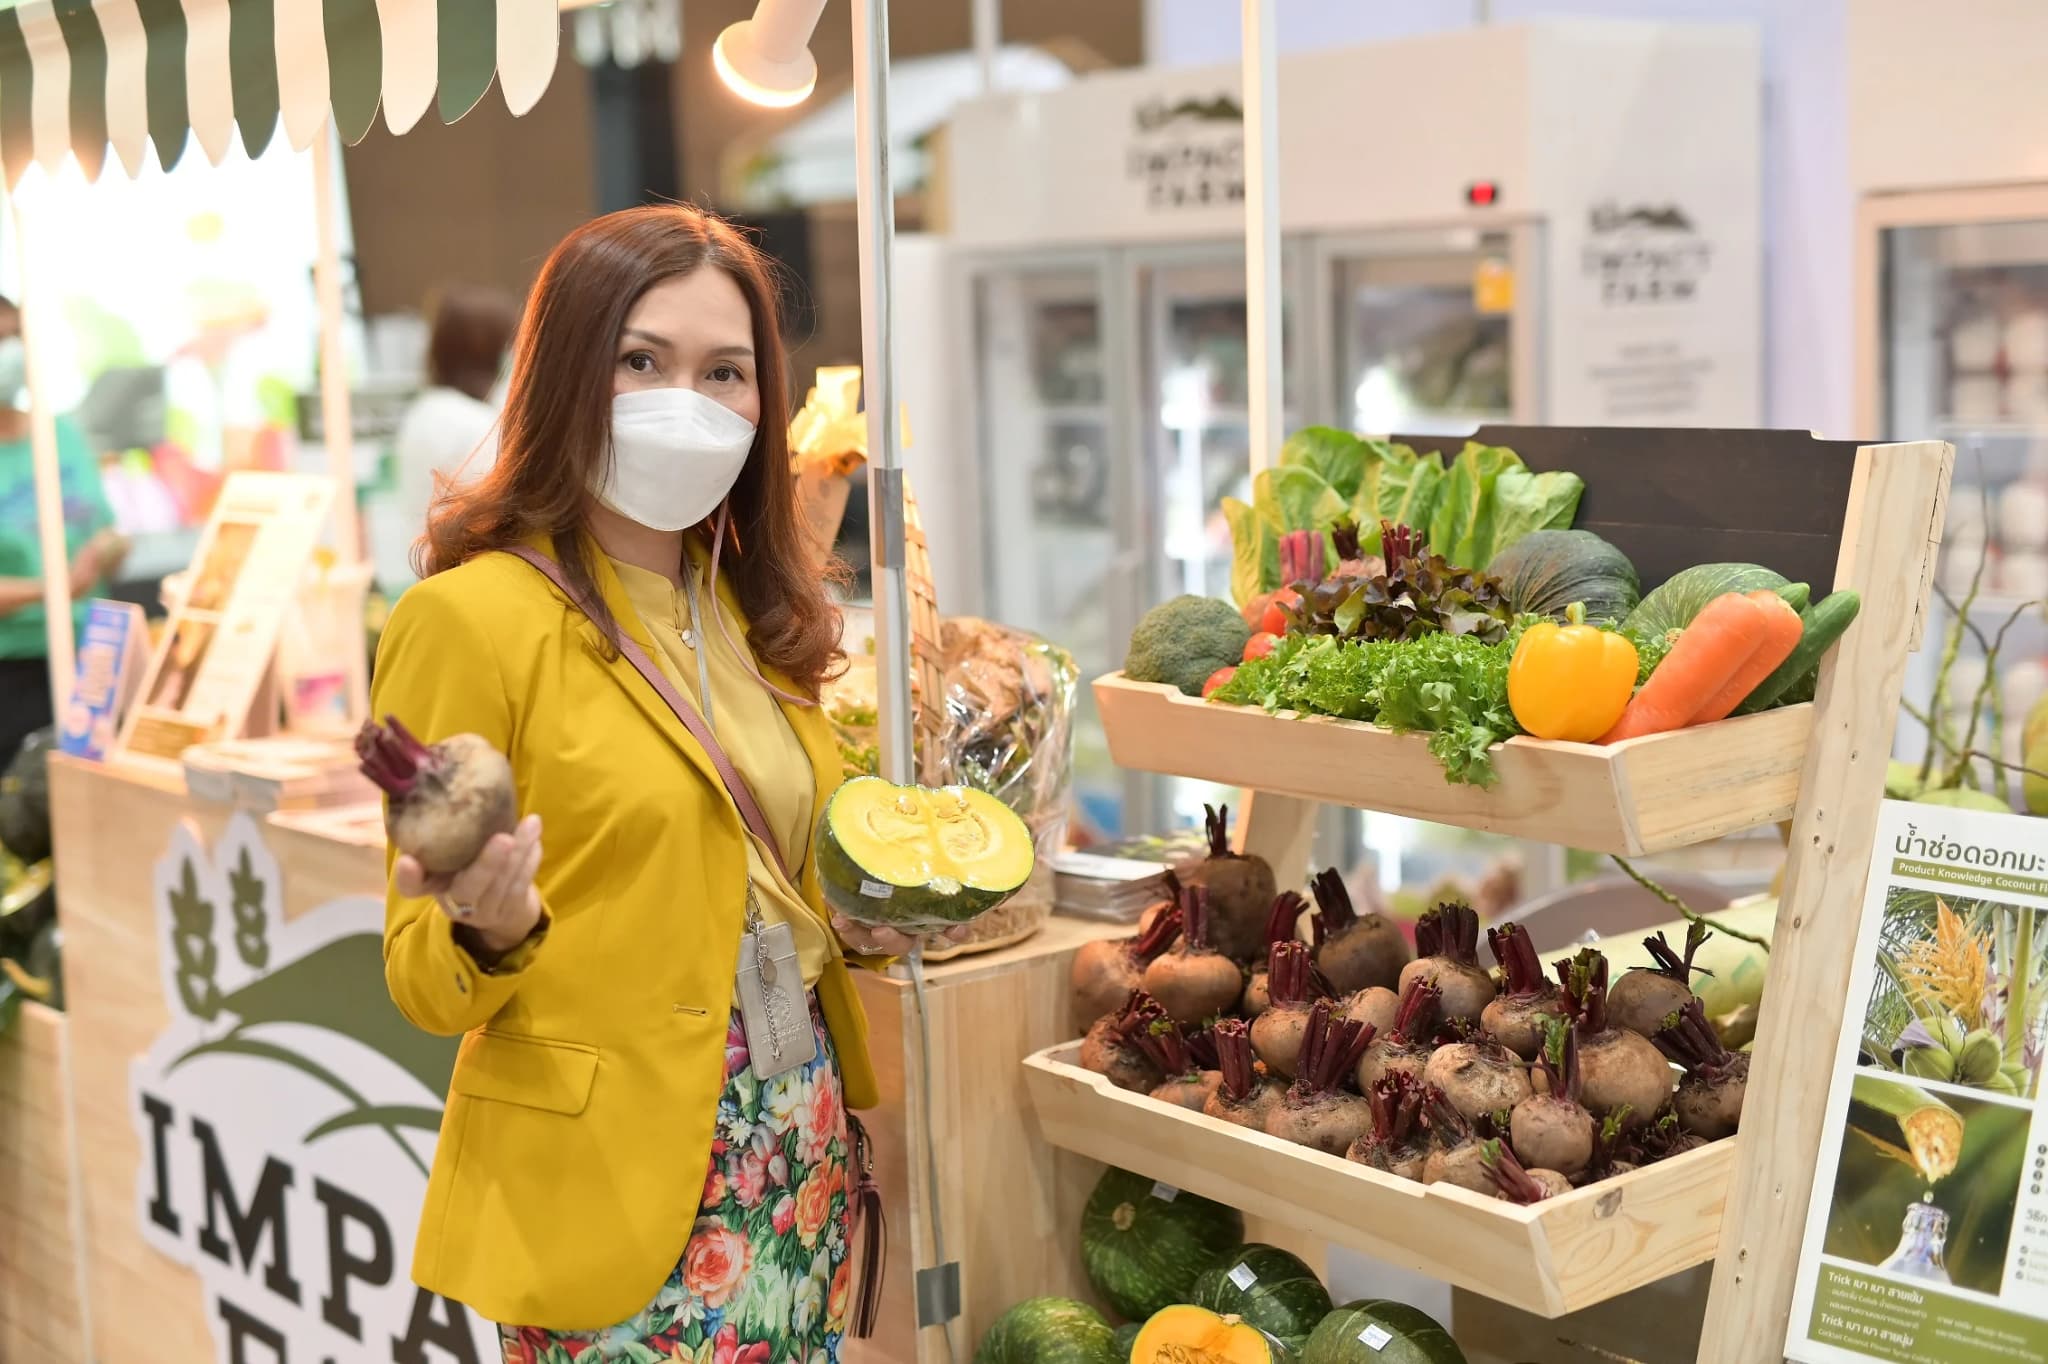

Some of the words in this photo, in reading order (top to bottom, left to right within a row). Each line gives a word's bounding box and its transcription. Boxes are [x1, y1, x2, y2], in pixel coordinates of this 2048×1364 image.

[1581, 238, 1713, 278] IMPACT
[1600, 277, 1698, 308] FARM
[1899, 862, 1935, 877] Product
[1938, 867, 1993, 885] Knowledge
[1995, 876, 2037, 892] Coconut
[1829, 1271, 1851, 1286] Trick
[1821, 1313, 1844, 1328] Trick
